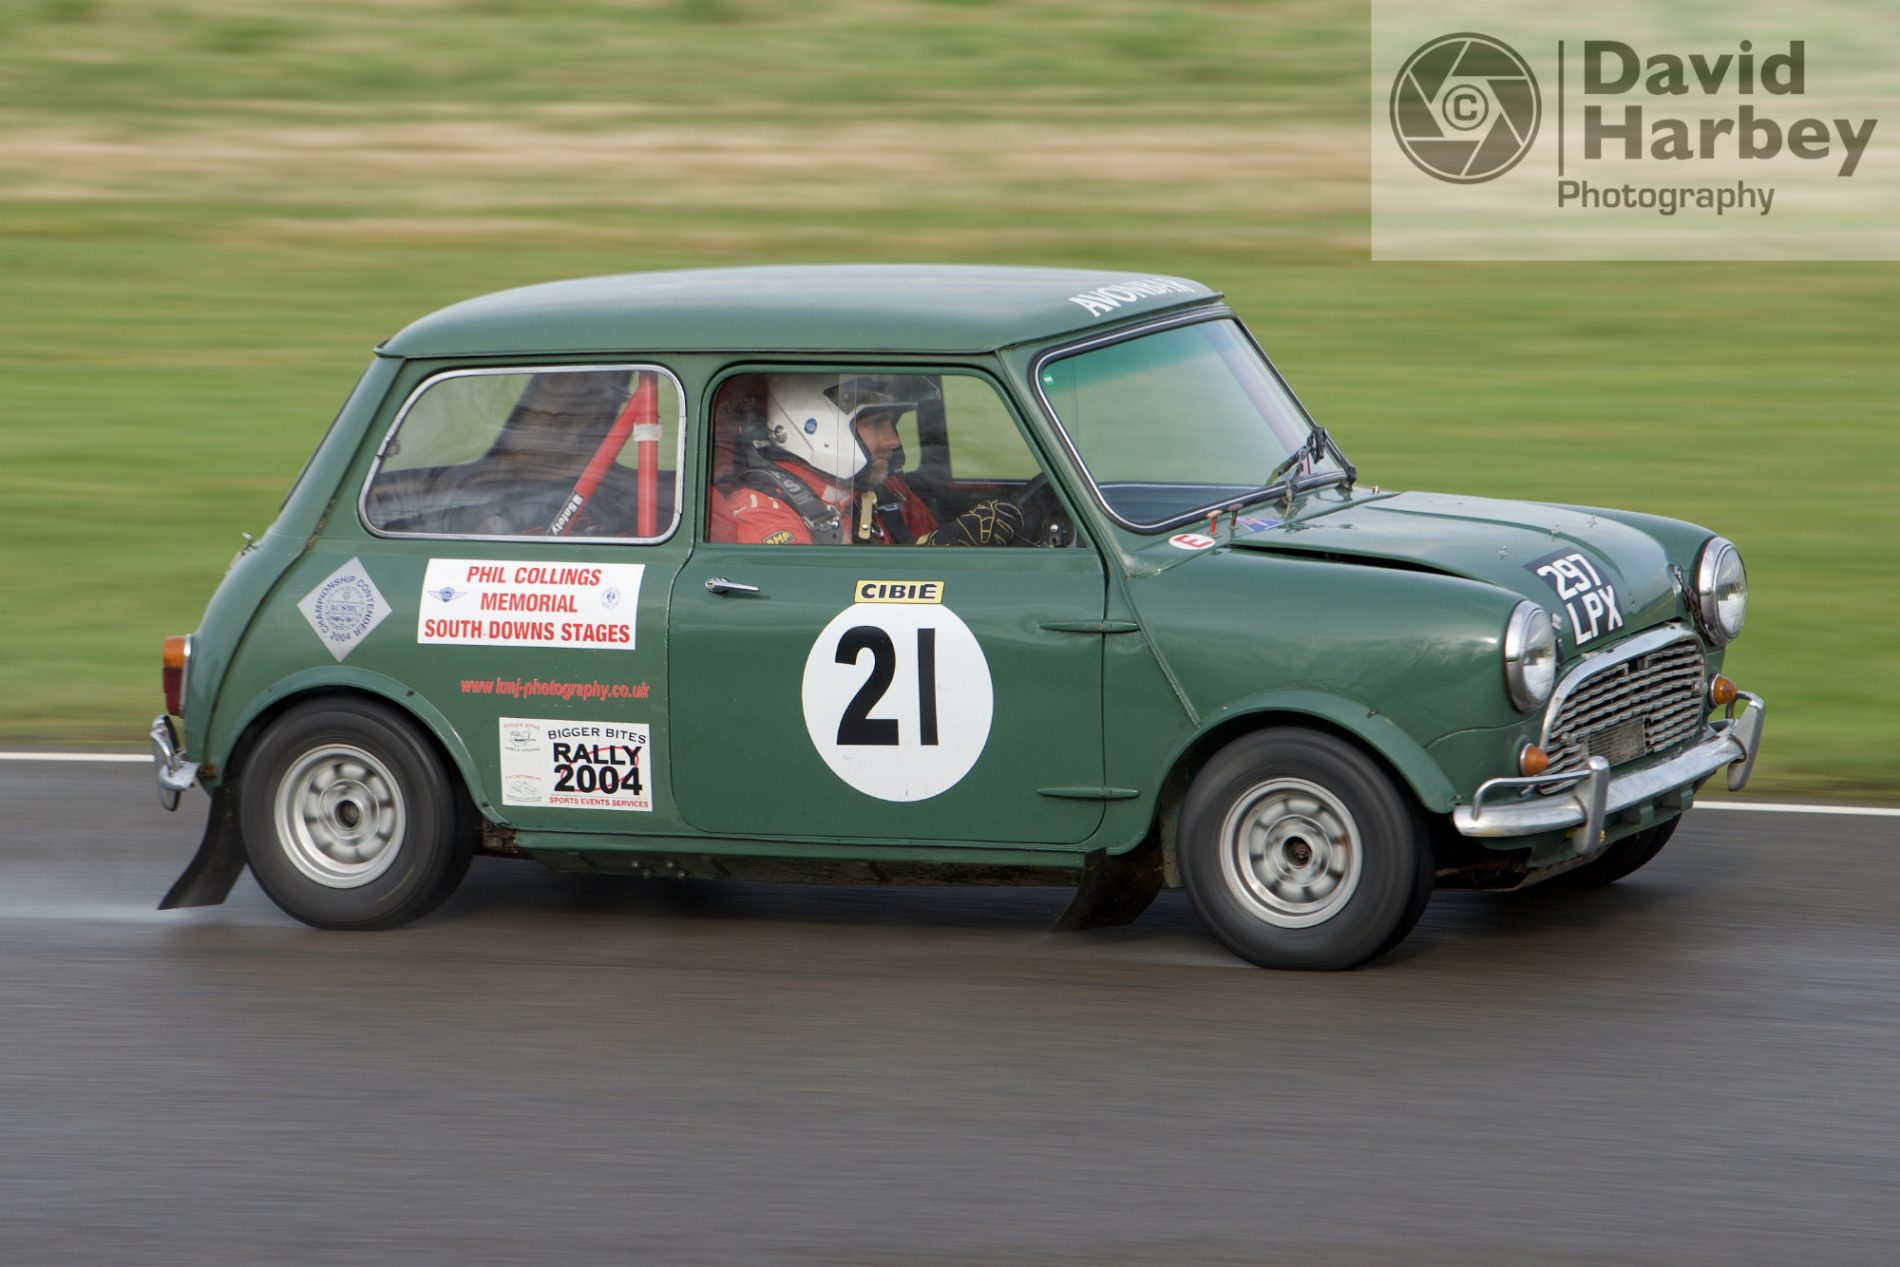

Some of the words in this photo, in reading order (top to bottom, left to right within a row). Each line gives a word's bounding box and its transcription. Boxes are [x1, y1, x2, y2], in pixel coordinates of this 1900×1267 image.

[466, 566, 507, 583] PHIL
[514, 567, 602, 586] COLLINGS
[1536, 553, 1602, 600] 297
[315, 575, 356, 634] CHAMPIONSHIP
[353, 579, 374, 637] CONTENDER
[480, 592, 578, 613] MEMORIAL
[1565, 585, 1624, 646] LPX
[329, 632, 352, 642] 2004
[424, 619, 483, 639] SOUTH
[488, 621, 555, 641] DOWNS
[561, 623, 630, 643] STAGES
[835, 625, 939, 746] 21
[548, 727, 600, 740] BIGGER
[605, 728, 646, 744] BITES
[553, 742, 642, 766] RALLY
[554, 764, 643, 796] 2004
[549, 796, 580, 804] SPORTS
[581, 797, 610, 806] EVENTS
[612, 799, 649, 808] SERVICES
